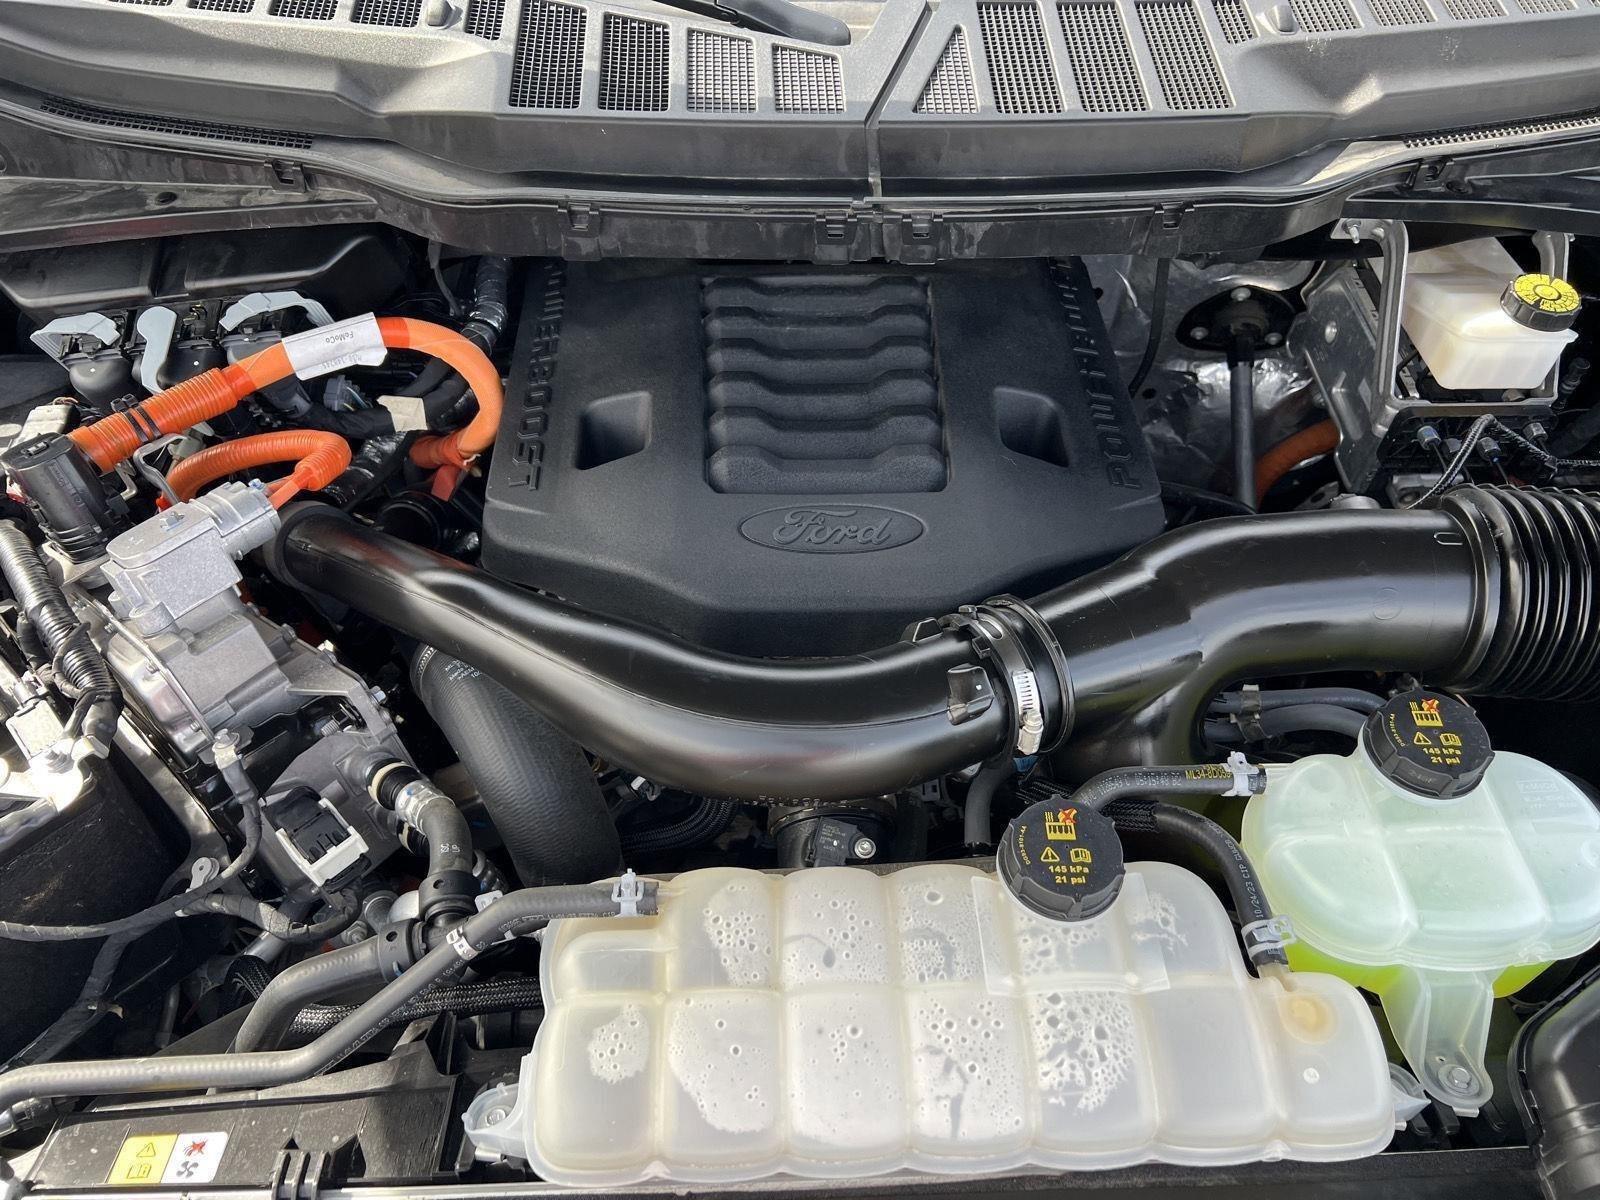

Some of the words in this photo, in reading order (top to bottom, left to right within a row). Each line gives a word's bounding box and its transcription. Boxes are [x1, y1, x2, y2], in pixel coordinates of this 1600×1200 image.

[325, 331, 354, 344] FoMoCo
[772, 509, 893, 545] Ford
[1422, 747, 1441, 755] 145
[1442, 747, 1462, 755] kPa
[1430, 756, 1443, 764] 21
[1445, 757, 1461, 765] psi
[1048, 865, 1067, 873] 145
[1069, 865, 1090, 873] kPa
[1239, 864, 1250, 879] CIP
[1055, 875, 1067, 884] 21
[1070, 875, 1086, 886] psi
[1245, 881, 1264, 918] 10/24/23
